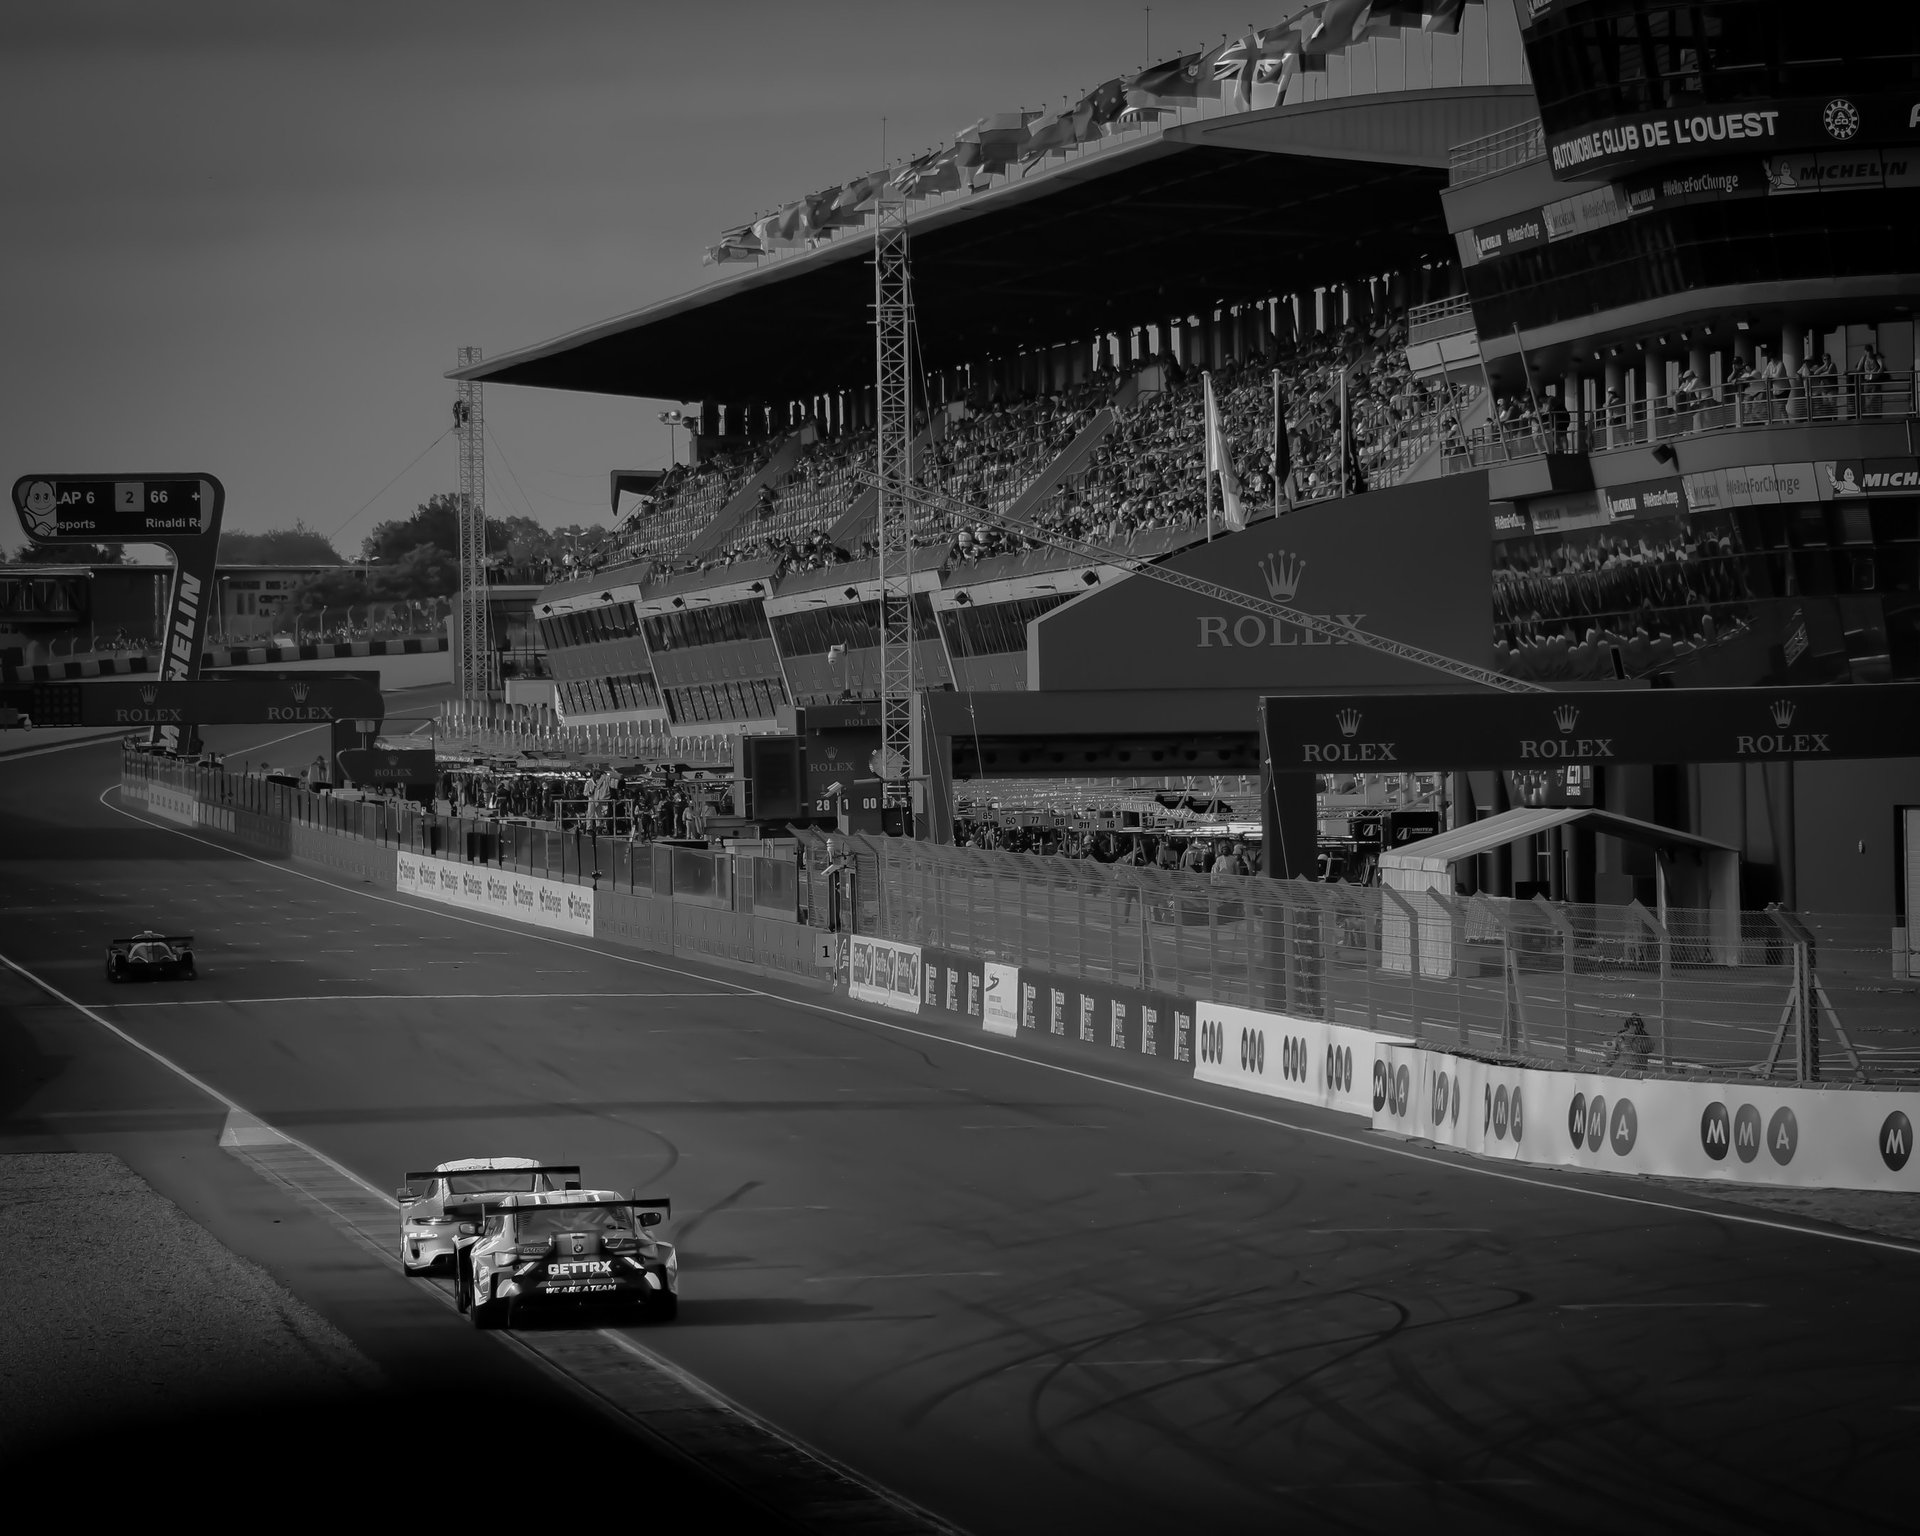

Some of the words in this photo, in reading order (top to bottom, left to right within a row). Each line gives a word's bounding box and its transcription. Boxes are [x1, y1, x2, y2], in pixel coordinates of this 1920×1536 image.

[1552, 132, 1603, 170] AUTOMOBILE
[1602, 125, 1640, 154] CLUB
[1642, 121, 1670, 148] DE
[1674, 111, 1779, 144] L'OUEST
[1799, 162, 1908, 181] MICHELIN
[1631, 187, 1656, 206] MICHELIN
[1862, 472, 1920, 487] MICH
[86, 491, 95, 504] 6
[126, 492, 134, 504] 2
[150, 491, 169, 504] 66
[146, 518, 186, 529] Rinaldi
[1196, 614, 1367, 650] ROLEX
[116, 708, 183, 723] ROLEX
[267, 706, 334, 721] ROLEX
[845, 718, 882, 728] ROLEX
[1519, 738, 1615, 758] ROLEX
[1736, 733, 1831, 754] ROLEX
[1302, 742, 1398, 763] ROLEX
[375, 768, 414, 777] ROLEX
[655, 765, 662, 773] 6
[669, 765, 676, 773] 5
[809, 762, 855, 773] ROLEX
[816, 799, 830, 811] 28
[863, 797, 878, 809] 00
[1006, 817, 1016, 825] 60
[1031, 816, 1040, 824] 77
[1078, 821, 1090, 829] 911
[1106, 820, 1115, 828] 16
[822, 945, 831, 958] 1
[547, 1261, 612, 1275] GETTRX
[590, 1284, 616, 1292] TEAM
